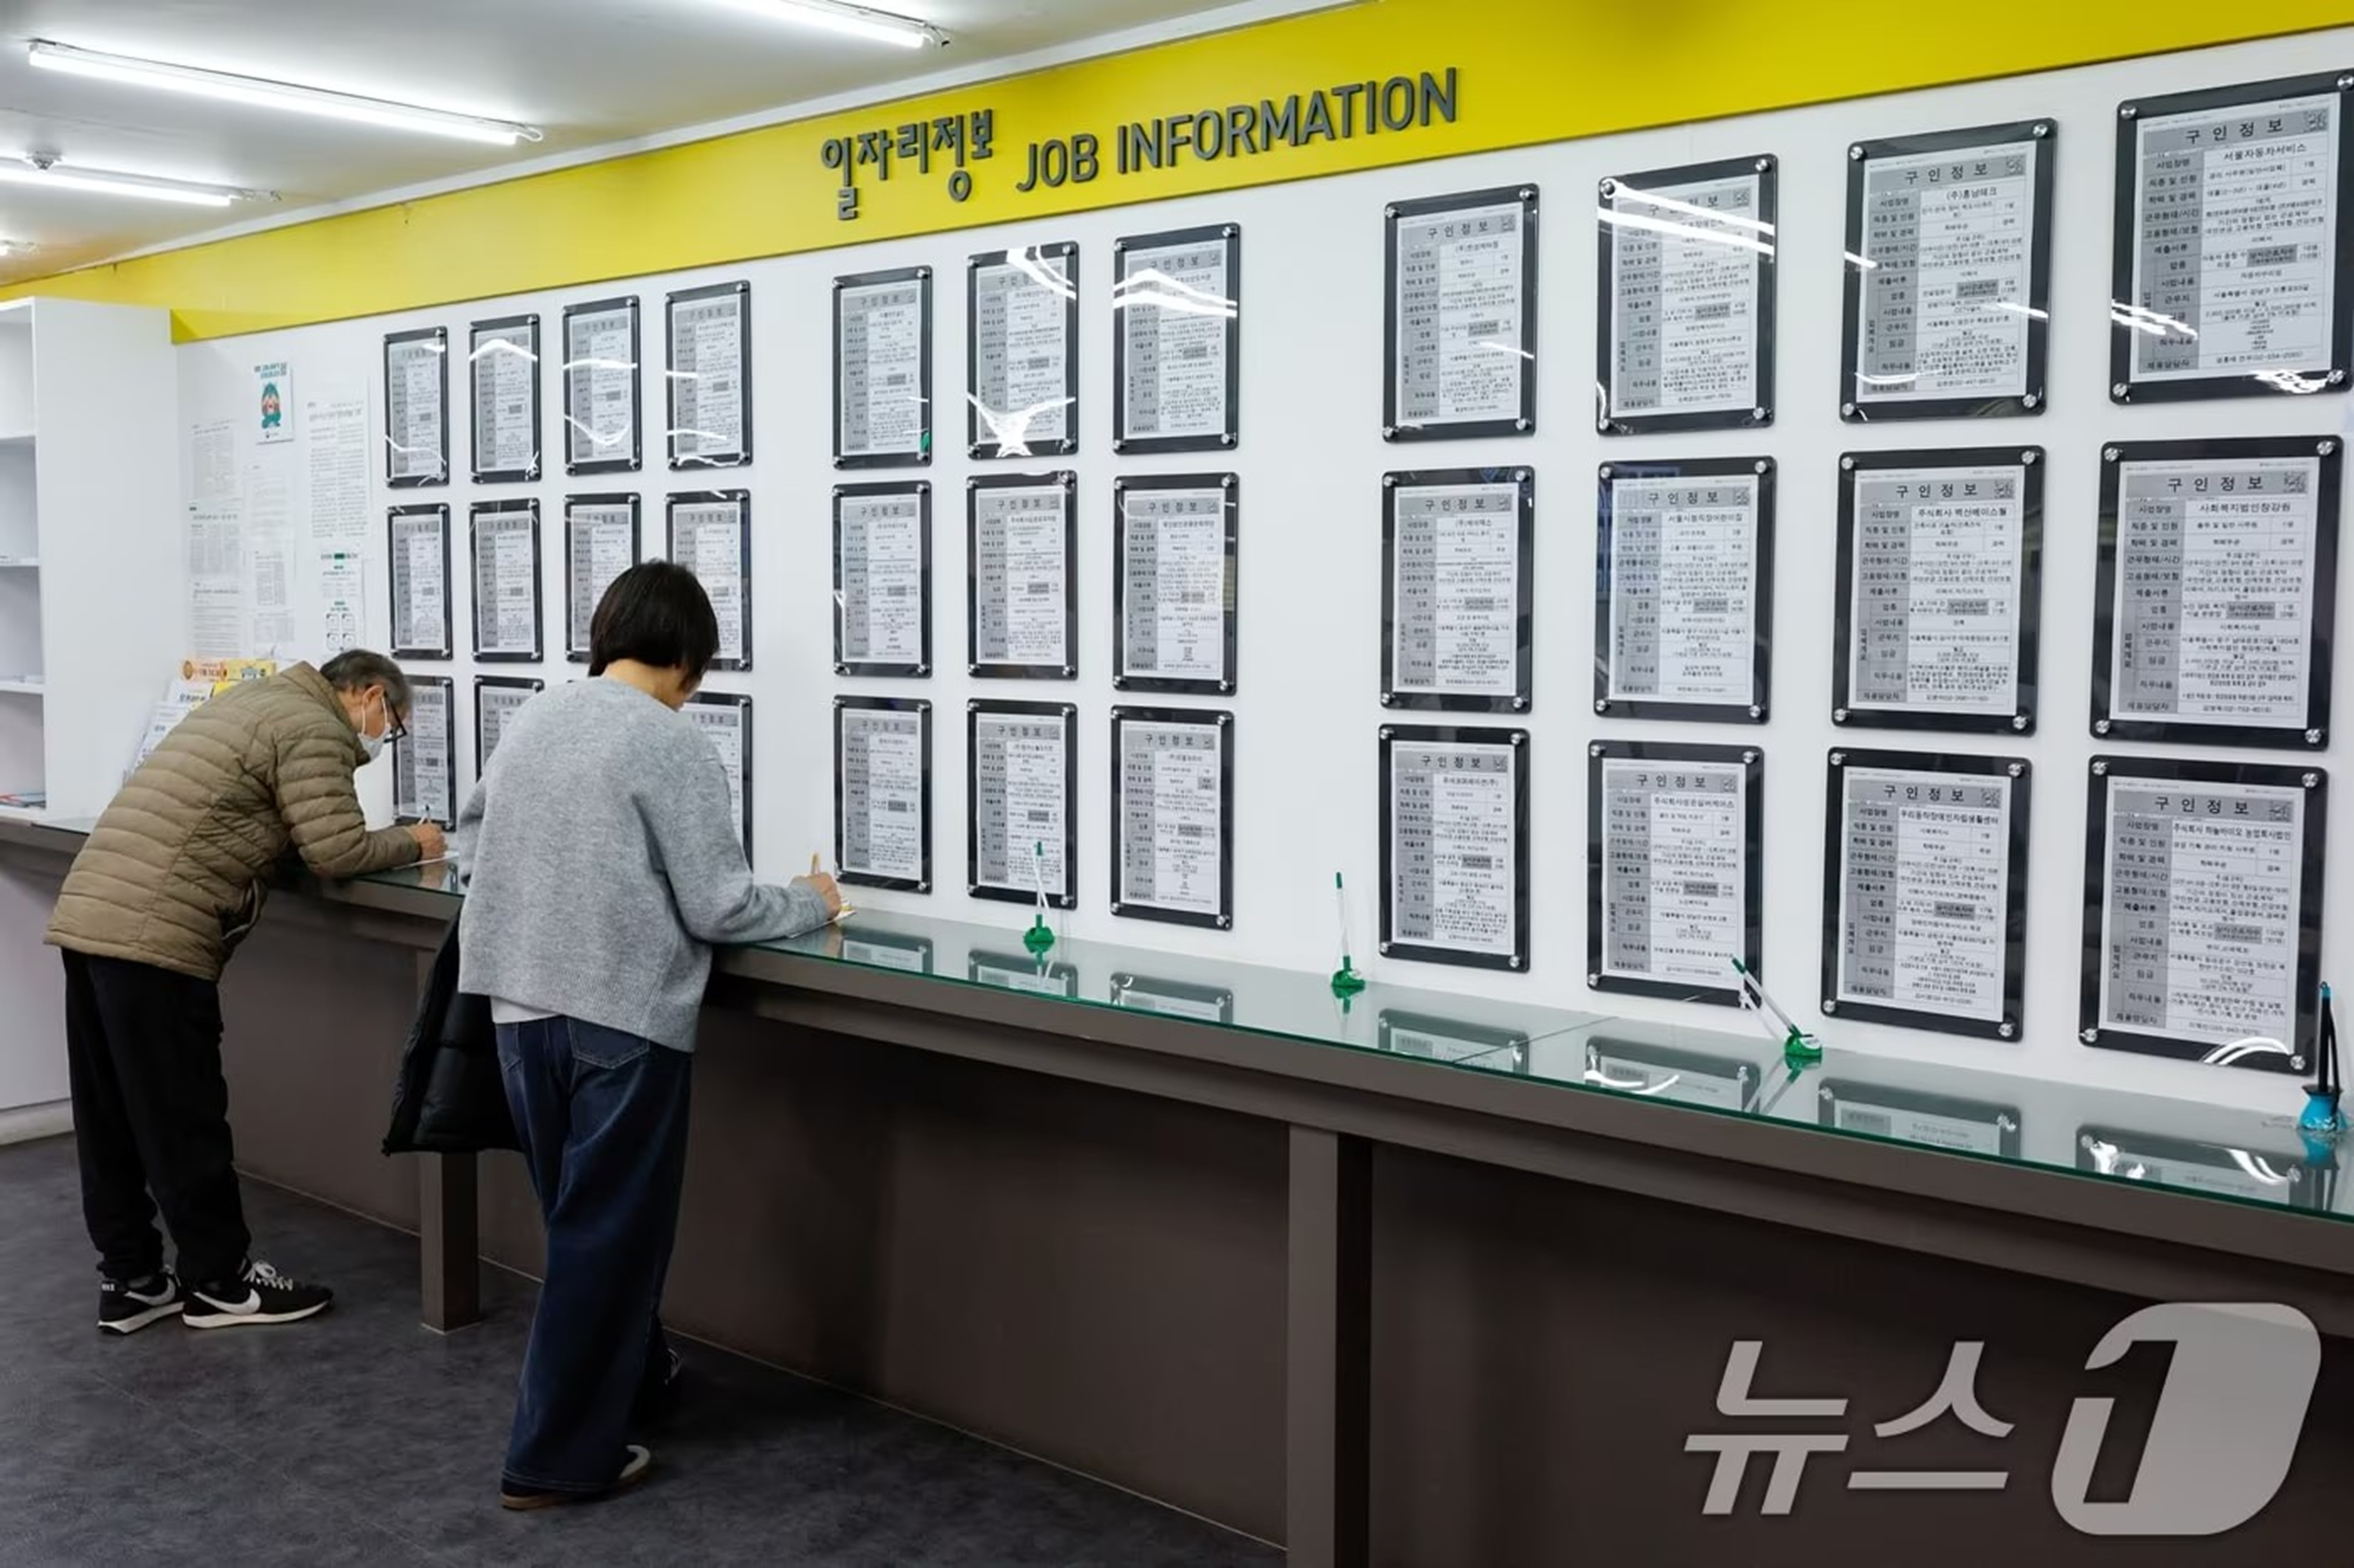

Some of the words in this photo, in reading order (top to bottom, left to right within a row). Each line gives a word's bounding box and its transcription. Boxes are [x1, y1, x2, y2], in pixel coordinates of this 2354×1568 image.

[1015, 133, 1100, 192] JOB
[1117, 66, 1458, 175] INFORMATION
[2185, 118, 2283, 144] 구인정보
[2224, 143, 2307, 161] 서울자동차서비스
[821, 108, 994, 221] 일자리정보
[1905, 164, 1987, 184] 구인정보
[1897, 484, 1978, 498] 구인정보
[2167, 475, 2264, 493] 구인정보
[1648, 492, 1719, 505] 구인정보
[1421, 756, 1480, 768] 구인정보
[1637, 774, 1706, 788] 구인정보
[1884, 786, 1964, 802] 구인정보
[2155, 796, 2249, 815] 구인정보
